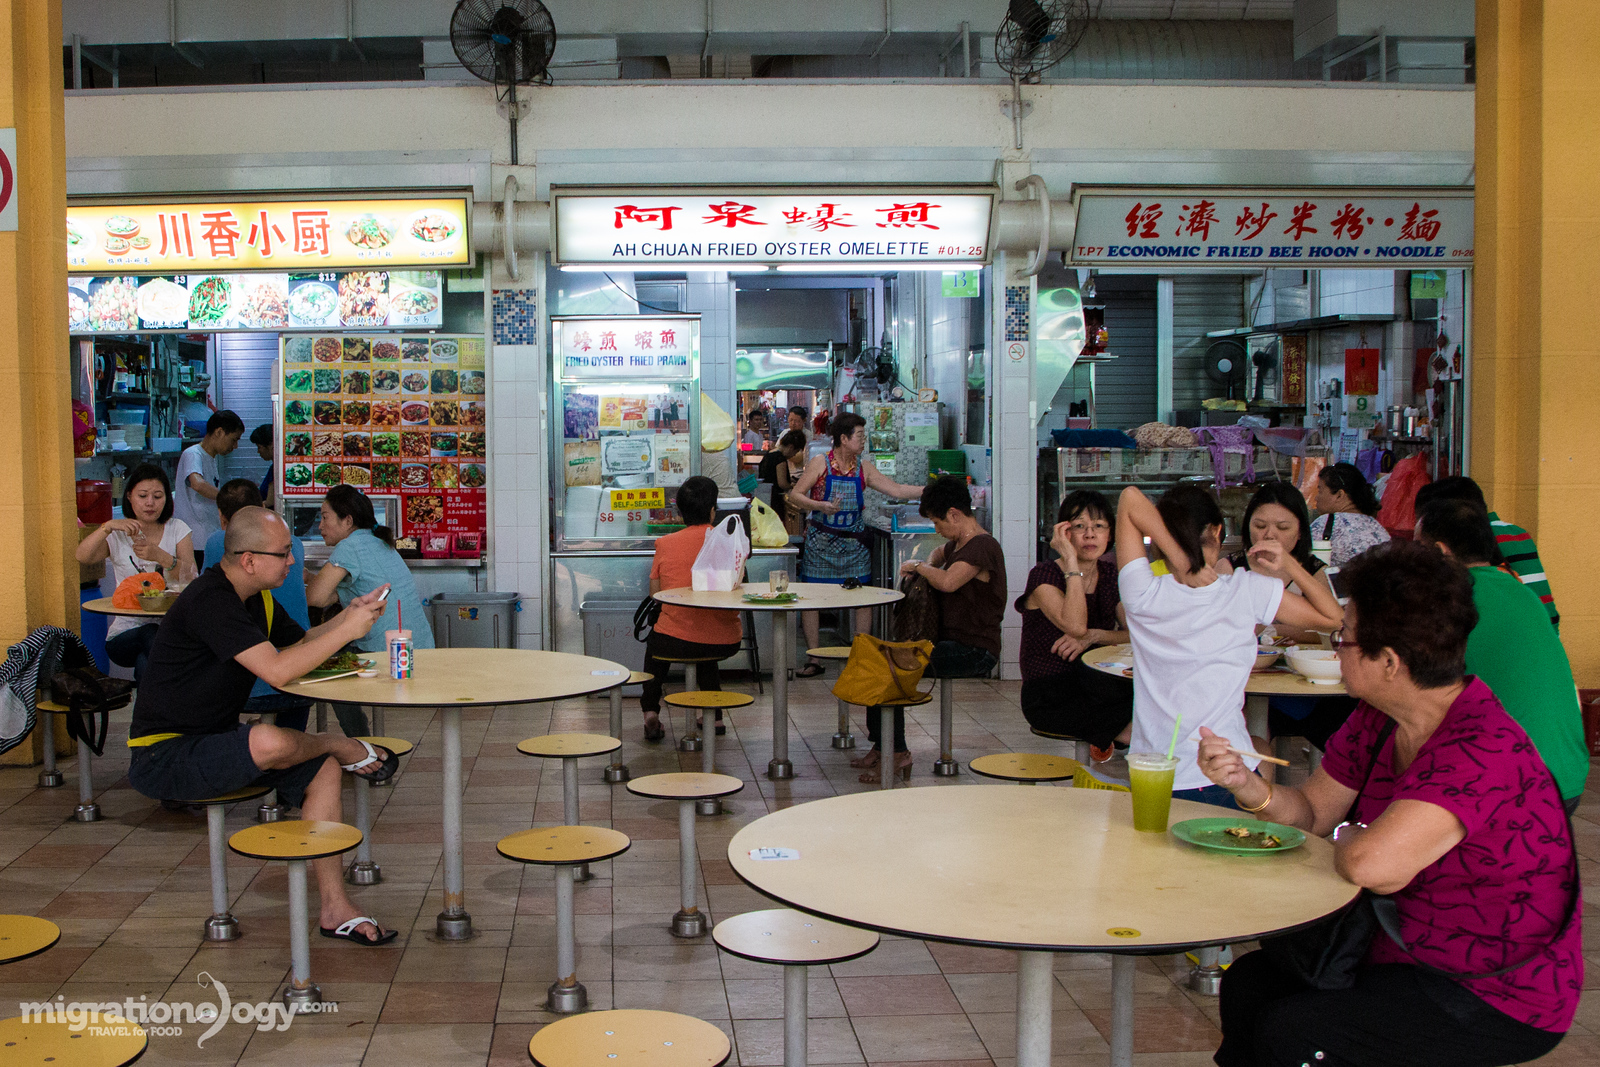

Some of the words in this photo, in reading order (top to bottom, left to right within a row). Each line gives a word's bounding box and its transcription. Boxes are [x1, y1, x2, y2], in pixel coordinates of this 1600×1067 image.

[614, 201, 942, 233] 阿泉蠔煎
[158, 211, 331, 257] 川香小厨
[612, 243, 636, 256] AH
[641, 243, 702, 256] CHUAN
[708, 243, 758, 256] FRIED
[764, 242, 831, 255] OYSTER
[838, 241, 929, 255] OMELETTE
[938, 246, 983, 256] #01-25
[1107, 245, 1201, 257] ECONOMIC
[1205, 246, 1264, 257] FRIED
[1268, 246, 1303, 257] BEE
[1307, 246, 1360, 257] HOON
[1375, 246, 1447, 257] NOODLE
[318, 273, 336, 282] $12
[565, 355, 589, 367] FRIED
[591, 355, 624, 367] OYSTER
[629, 355, 654, 366] FRIED
[657, 355, 687, 366] PRAWN
[1356, 397, 1368, 412] 9
[616, 491, 660, 501] 自助服務
[599, 512, 615, 523] $8
[627, 511, 642, 522] $5
